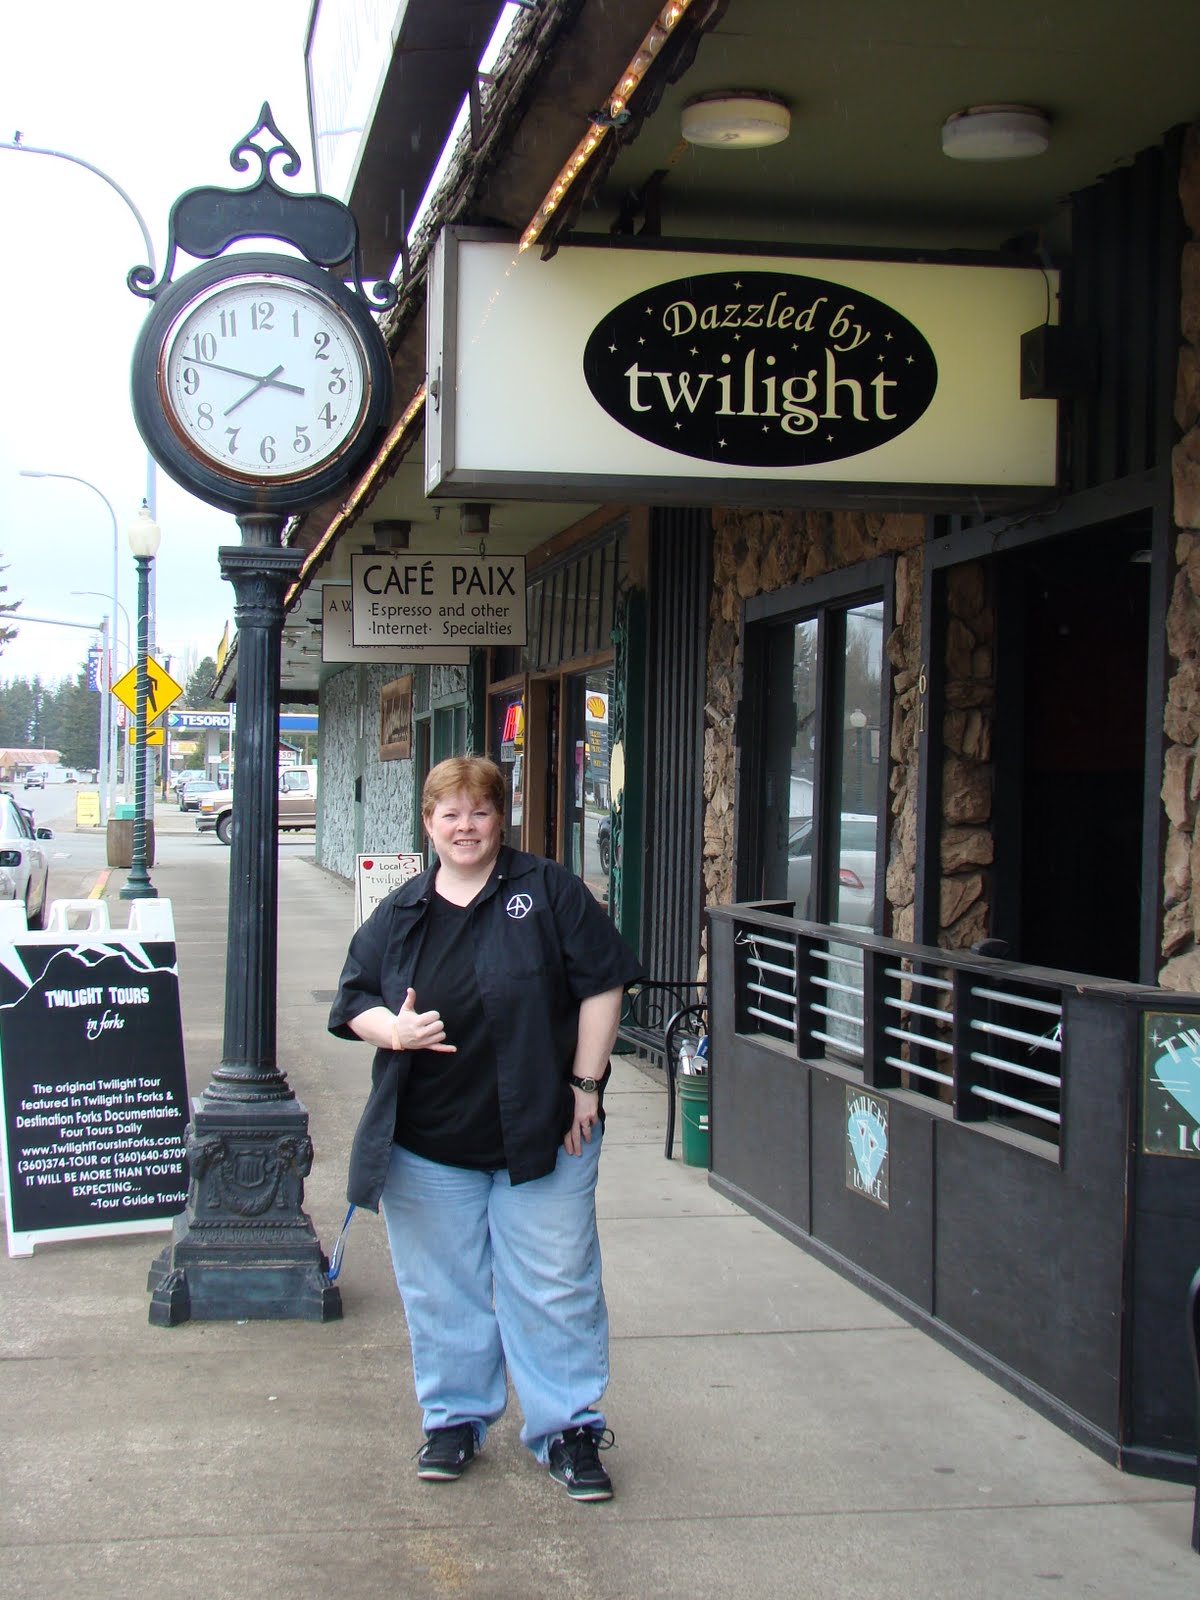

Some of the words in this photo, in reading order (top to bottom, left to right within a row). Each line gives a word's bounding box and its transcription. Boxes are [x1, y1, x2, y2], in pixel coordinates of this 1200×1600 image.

[219, 309, 237, 337] 11
[250, 301, 275, 331] 12
[292, 309, 300, 338] 1
[662, 292, 827, 337] Dazzled
[828, 304, 871, 351] by
[193, 332, 217, 361] 10
[314, 331, 330, 361] 2
[183, 367, 200, 396] 9
[328, 367, 346, 395] 3
[624, 348, 898, 435] twilight
[197, 402, 214, 431] 8
[318, 401, 338, 429] 4
[224, 427, 242, 455] 7
[260, 435, 276, 464] 6
[293, 425, 311, 454] 5
[363, 560, 434, 596] CAFÉ
[452, 565, 516, 596] PAIX
[438, 603, 465, 617] and
[471, 604, 510, 617] other
[442, 621, 512, 638] Specialties
[181, 714, 230, 727] TESORO
[379, 863, 401, 871] Local
[45, 987, 103, 1008] TWILIGHT
[108, 986, 150, 1005] TOURS
[86, 1018, 98, 1031] in
[87, 1009, 125, 1040] forks
[33, 1084, 52, 1094] The
[55, 1081, 96, 1094] original
[98, 1077, 137, 1091] Twilight
[138, 1077, 161, 1088] Tour
[21, 1097, 69, 1110] featured
[71, 1097, 81, 1107] in
[83, 1093, 123, 1107] Twilight
[125, 1094, 135, 1104] in
[137, 1091, 164, 1102] Forks
[166, 1091, 174, 1100] &
[16, 1113, 74, 1128] Destination
[76, 1111, 102, 1123] Forks
[104, 1106, 182, 1122] Documentaries.
[60, 1127, 84, 1138] Four
[86, 1125, 113, 1136] Tours
[116, 1123, 143, 1135] Daily
[22, 1136, 181, 1157] www.TwilightToursInForks.com
[18, 1154, 98, 1173] (360)374-TOUR
[100, 1154, 111, 1165] or
[26, 1175, 34, 1186] IT
[37, 1173, 62, 1186] WILL
[64, 1172, 77, 1183] BE
[80, 1169, 111, 1182] MORE
[114, 1166, 143, 1179] THAN
[145, 1163, 182, 1176] YOU'RE
[72, 1182, 141, 1197] EXPECTING...
[122, 1193, 154, 1206] Guide
